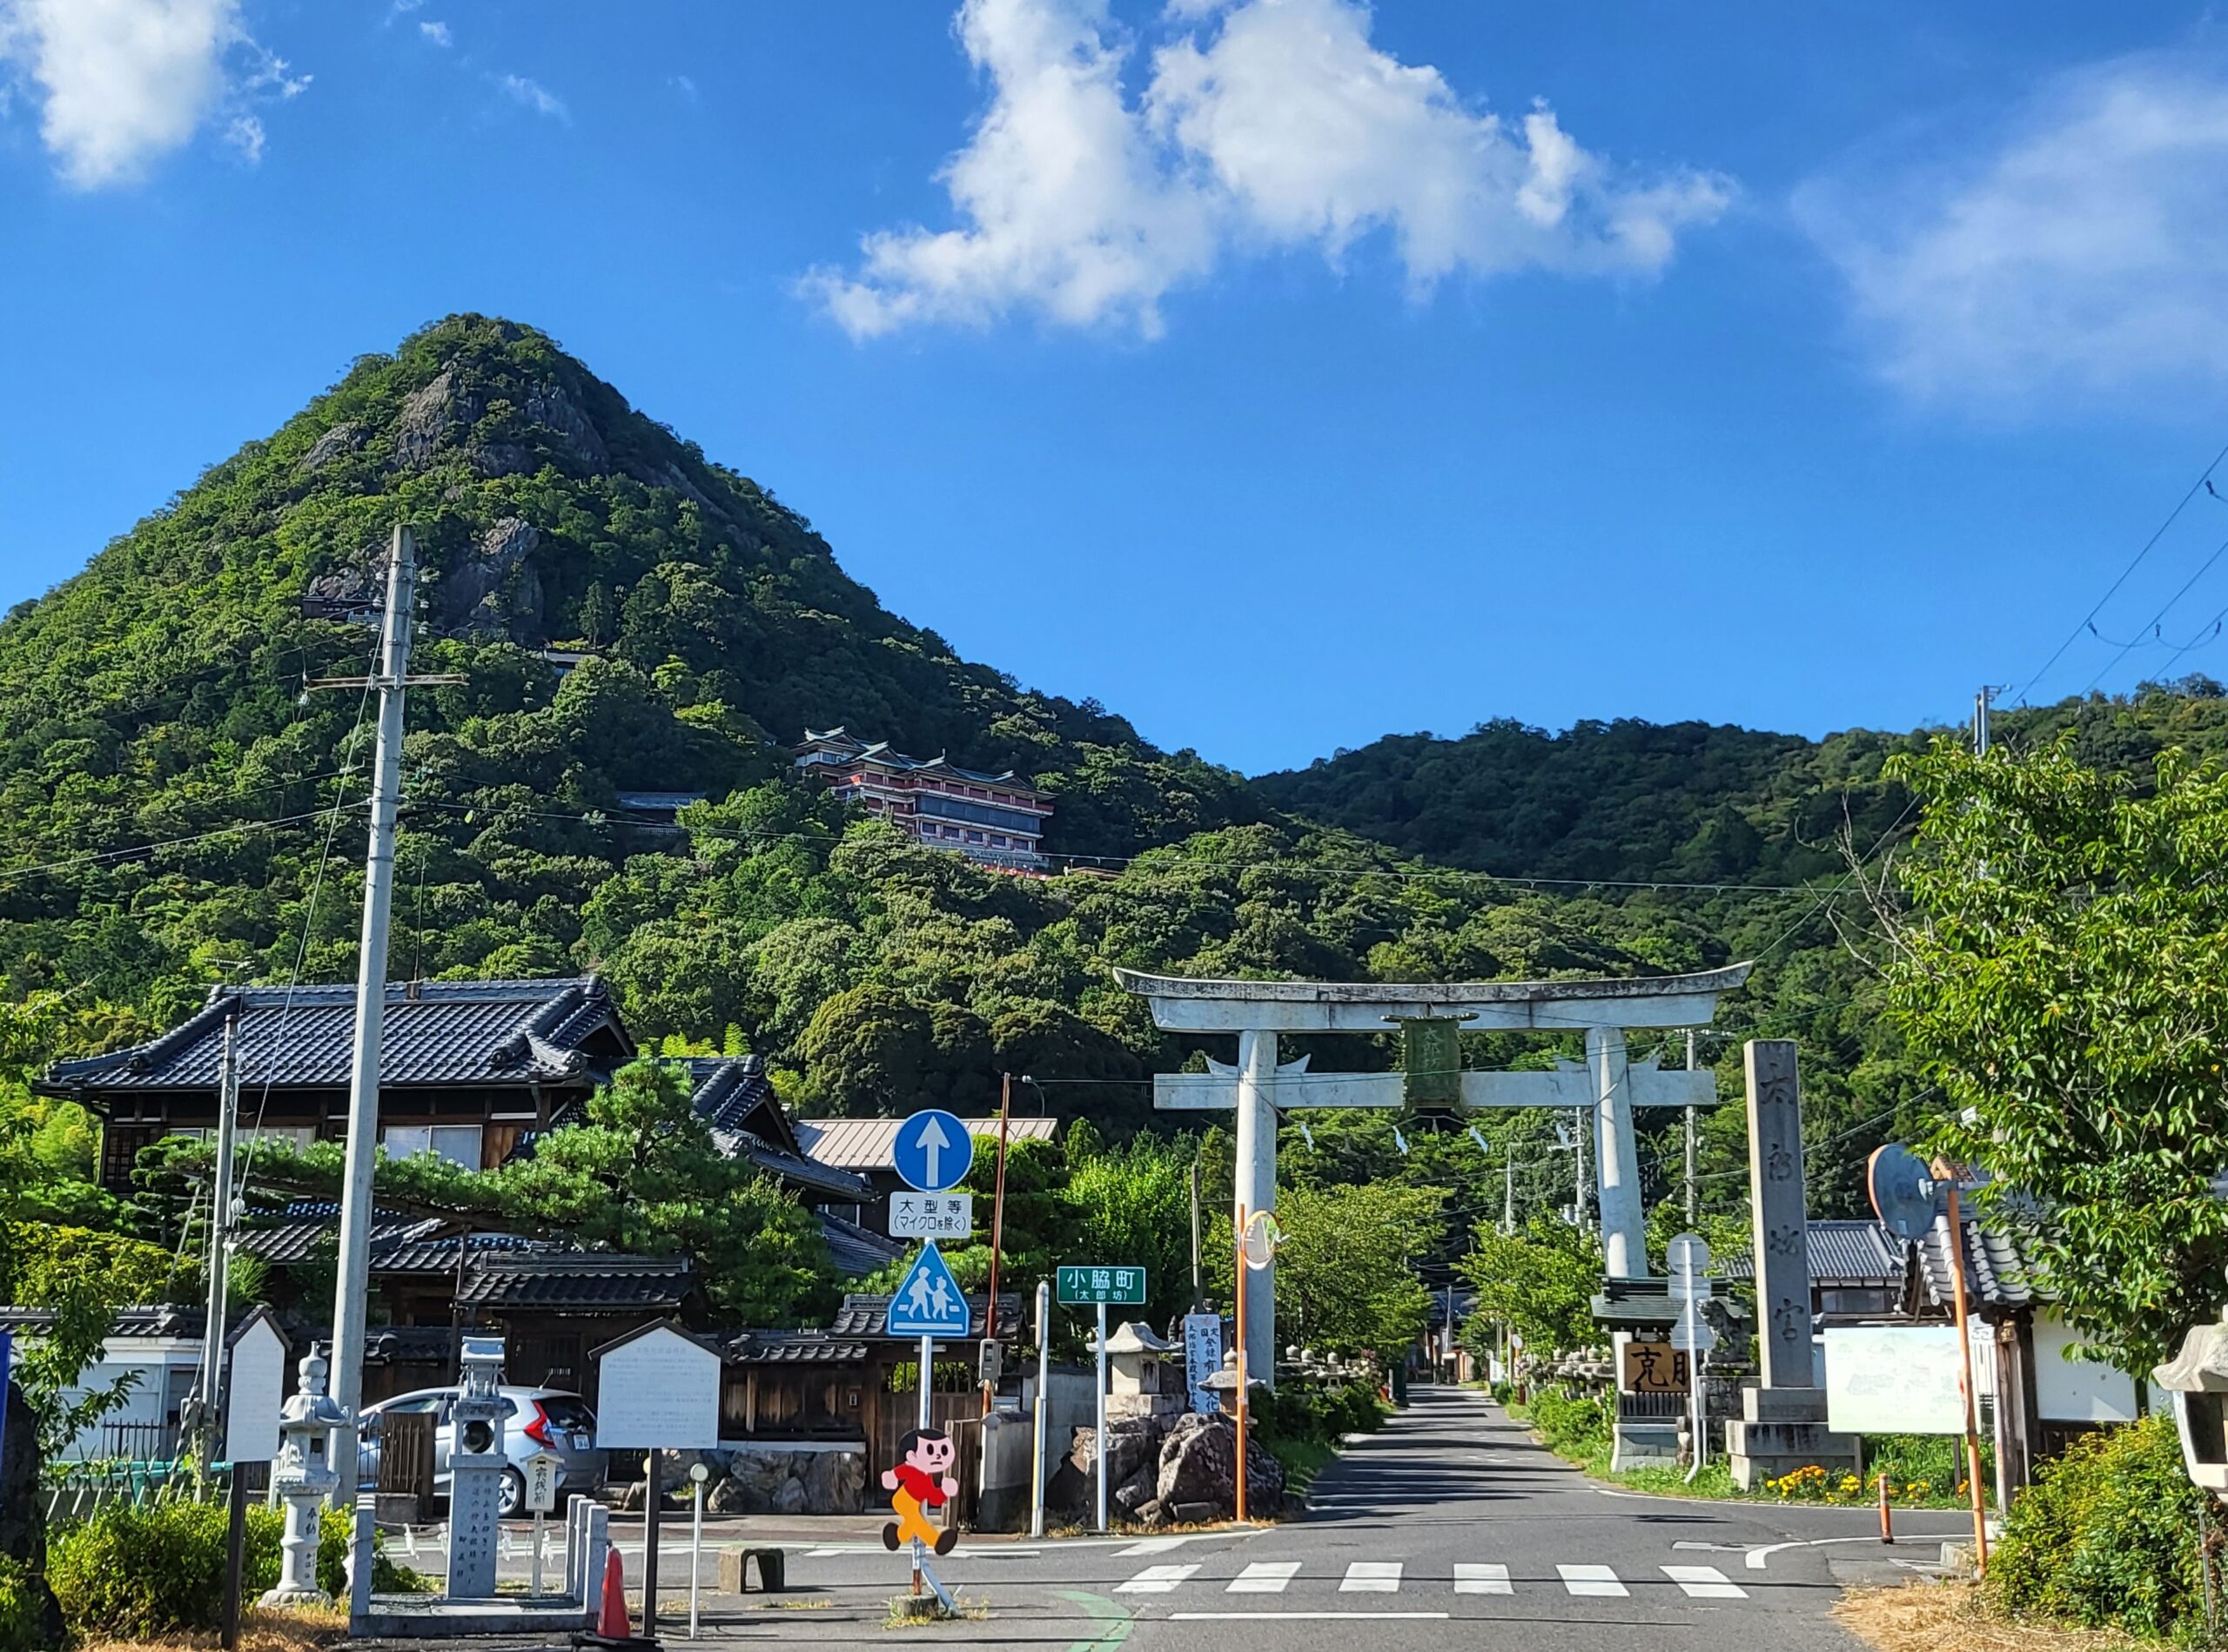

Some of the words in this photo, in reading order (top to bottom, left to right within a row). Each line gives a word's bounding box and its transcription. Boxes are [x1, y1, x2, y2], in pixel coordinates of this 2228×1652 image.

[899, 1199, 962, 1214] 大型等
[894, 1214, 966, 1232] (マイクロを除く)
[1067, 1269, 1135, 1290] 小脇町
[1075, 1290, 1127, 1300] (太郎坊)
